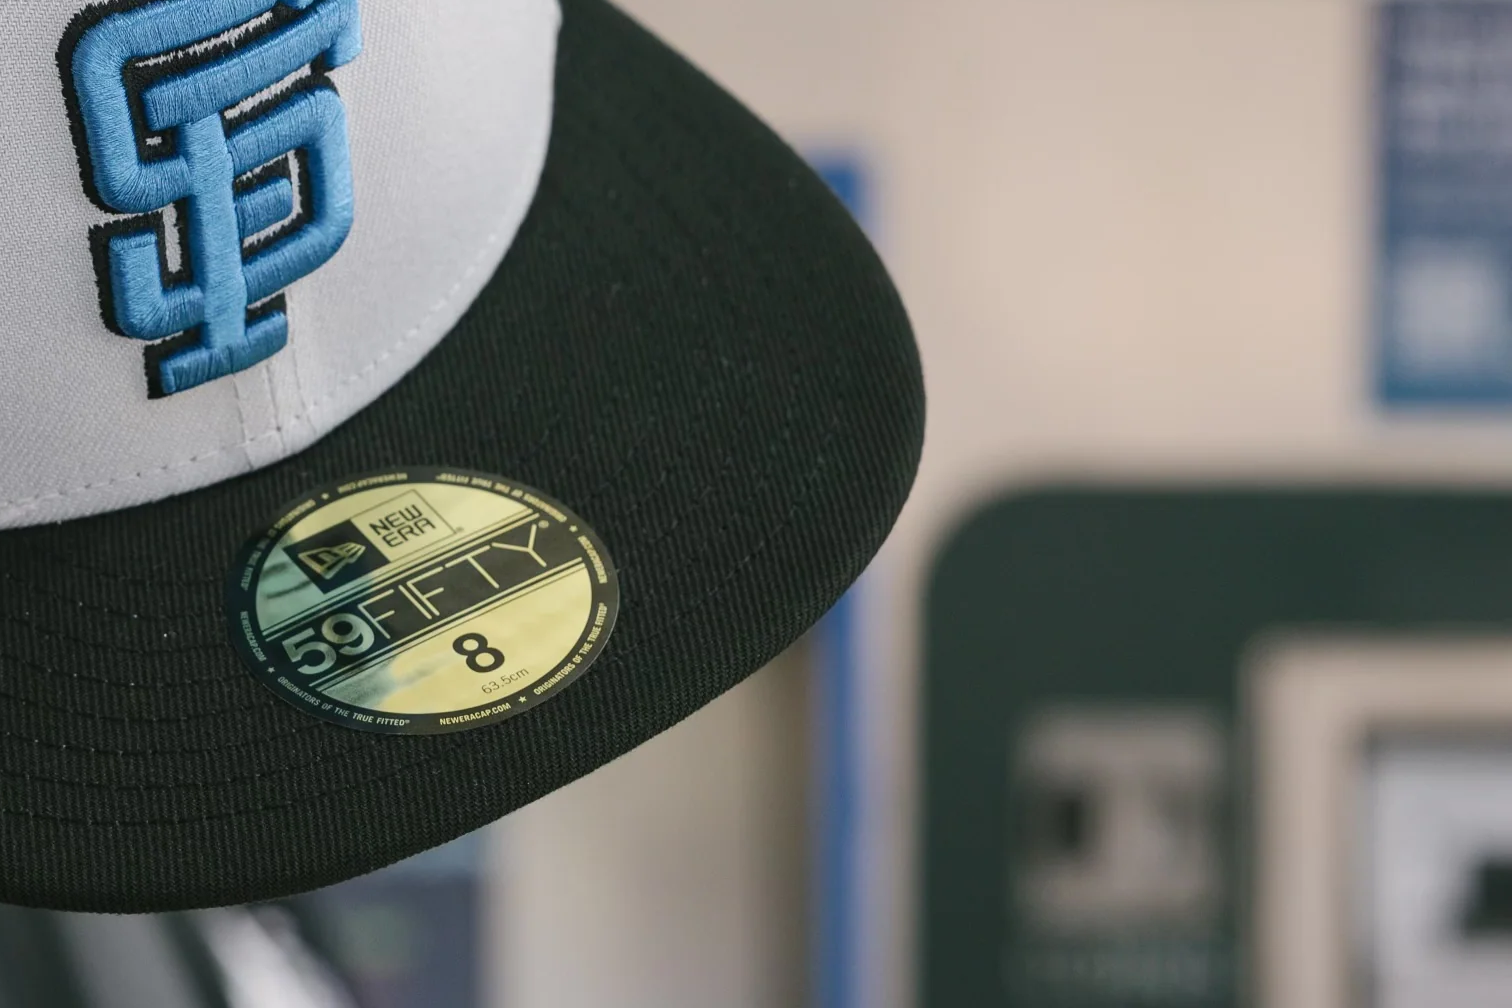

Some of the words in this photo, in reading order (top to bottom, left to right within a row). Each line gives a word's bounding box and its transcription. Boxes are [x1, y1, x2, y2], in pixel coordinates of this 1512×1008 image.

[369, 504, 423, 536] NEW
[382, 516, 436, 547] ERA
[452, 632, 505, 673] 8
[533, 662, 576, 695] ORIGINATORS
[572, 654, 583, 664] OF
[579, 639, 593, 655] THE
[587, 624, 602, 642] TRUE
[481, 667, 530, 695] 63.5cm
[277, 676, 320, 706] ORIGINATORS
[322, 701, 332, 711] OF
[335, 707, 349, 718] THE
[352, 712, 374, 724] TRUE
[439, 702, 512, 726] NEWERACAP.COM
